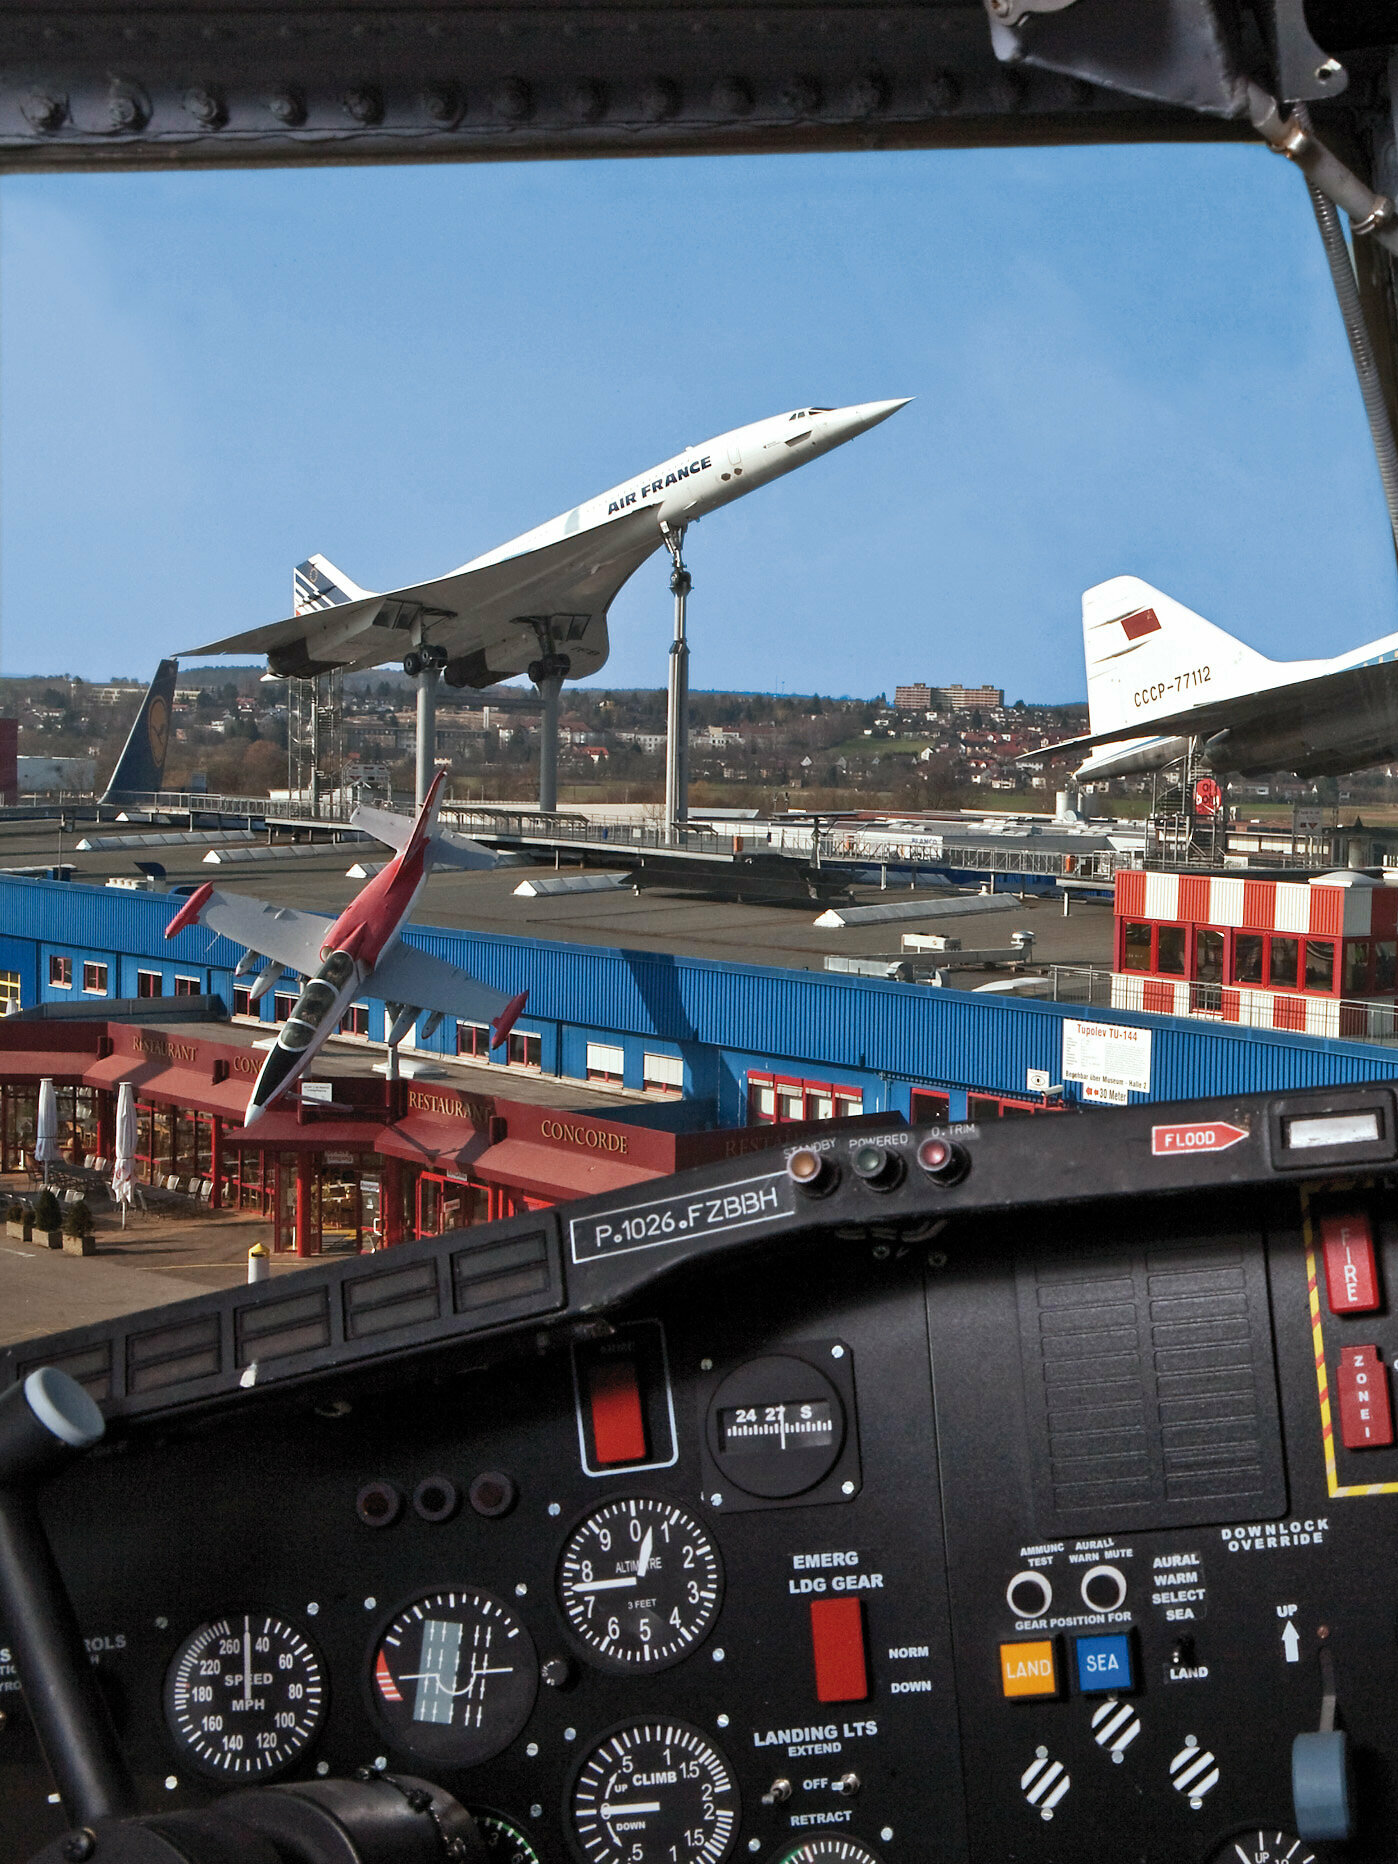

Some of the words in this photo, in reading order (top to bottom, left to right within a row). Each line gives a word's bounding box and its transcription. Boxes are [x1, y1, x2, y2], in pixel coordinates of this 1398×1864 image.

[607, 492, 636, 516] AIR
[641, 456, 712, 499] FRANCE
[1077, 1024, 1106, 1037] Tupolev
[1109, 1029, 1137, 1040] TU-144
[132, 1036, 198, 1062] RESTAURANT
[1100, 1088, 1107, 1098] 30
[1109, 1089, 1126, 1101] Meter
[408, 1091, 490, 1124] RESTAURANT
[541, 1119, 628, 1154] CONCORDE
[849, 1133, 908, 1149] POWERED
[1164, 1130, 1216, 1148] FLOOD
[1341, 1228, 1358, 1302] FIRE
[736, 1409, 757, 1423] 24
[800, 1405, 812, 1419] S
[661, 1521, 669, 1543] 1
[1221, 1518, 1329, 1541] DOWNLOCK
[1020, 1543, 1065, 1556] AMMUNC
[1228, 1532, 1324, 1553] OVERRIDE
[683, 1546, 694, 1568] 2
[793, 1551, 859, 1570] EMERG
[1028, 1556, 1053, 1567] TEST
[1069, 1552, 1099, 1564] WARN
[1104, 1549, 1133, 1559] MUTE
[1153, 1554, 1200, 1569] AURAL
[582, 1560, 593, 1582] 8
[1155, 1571, 1198, 1586] WARM
[789, 1578, 827, 1594] LDG
[832, 1574, 883, 1591] GEAR
[687, 1581, 699, 1604] 3
[1152, 1588, 1206, 1605] SELECT
[635, 1599, 657, 1609] FEET
[1277, 1604, 1298, 1618] UP
[1015, 1619, 1048, 1631] GEAR
[1050, 1614, 1105, 1628] POSITION
[1108, 1611, 1132, 1623] FOR
[1166, 1608, 1194, 1621] SEA
[640, 1618, 651, 1641] 5
[219, 1640, 240, 1654] 260
[889, 1646, 929, 1659] NORM
[1006, 1659, 1052, 1679] LAND
[1086, 1653, 1119, 1672] SEA
[224, 1673, 273, 1687] SPEED
[1170, 1666, 1209, 1681] LAND
[288, 1684, 303, 1699] 80
[891, 1681, 932, 1694] DOWN
[232, 1698, 265, 1711] MPH
[754, 1724, 838, 1747] LANDING
[843, 1721, 878, 1737] LTS
[788, 1742, 842, 1757] EXTEND
[633, 1771, 678, 1786] CLIMB
[803, 1778, 828, 1790] OFF
[614, 1784, 628, 1793] UP
[616, 1821, 646, 1831] DOWN
[790, 1810, 852, 1826] RETRACT
